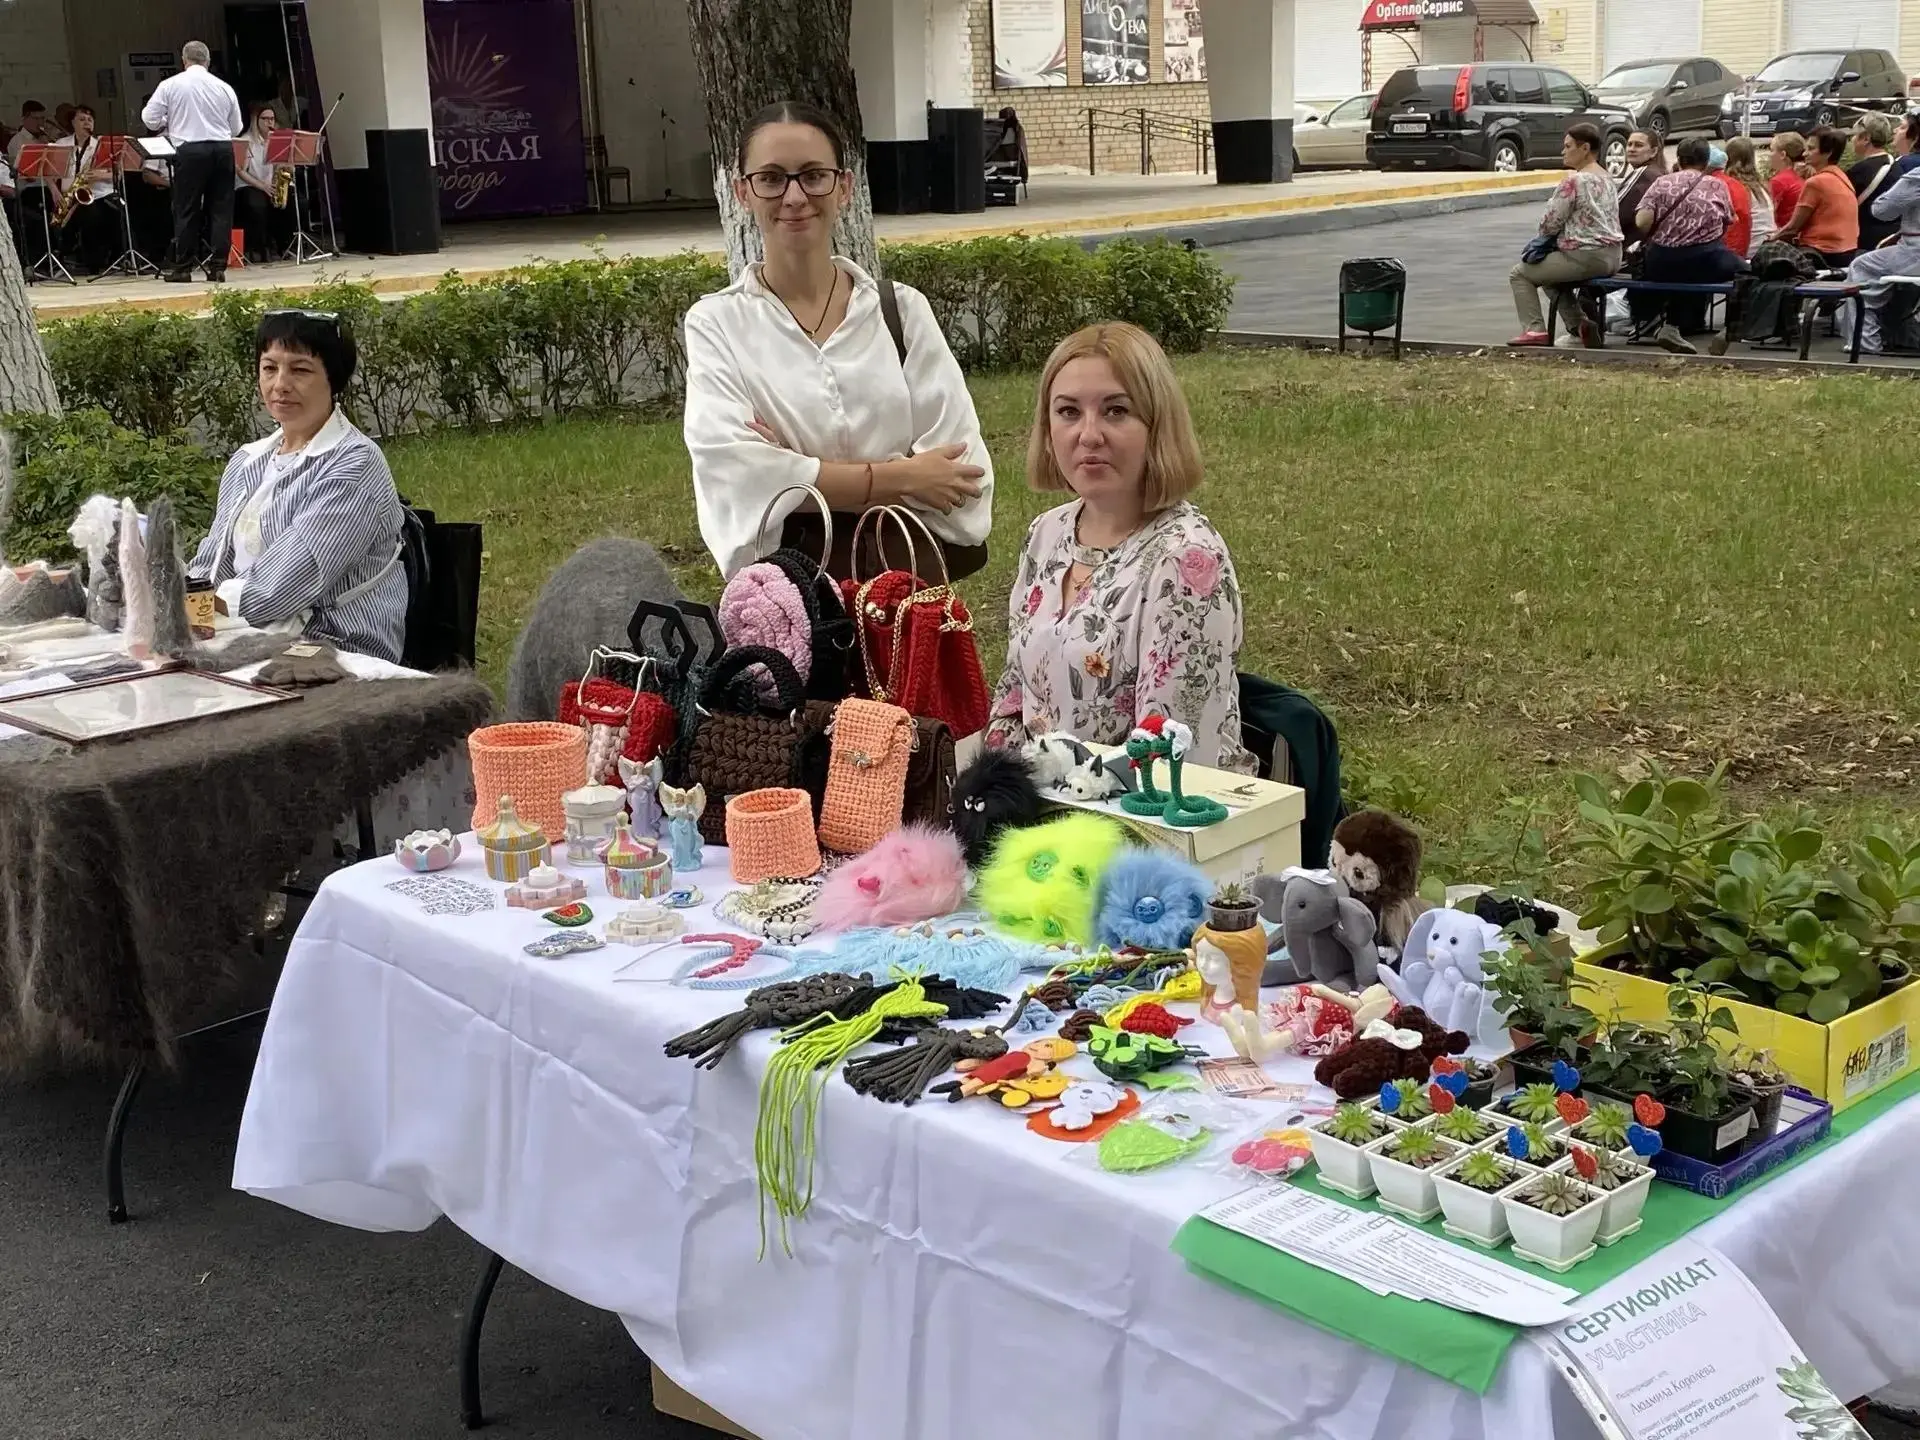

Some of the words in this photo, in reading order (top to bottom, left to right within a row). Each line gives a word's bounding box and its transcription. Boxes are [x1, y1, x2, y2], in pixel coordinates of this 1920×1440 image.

[1376, 0, 1464, 20] ОрТеплоСервис
[1563, 1257, 1718, 1344] СЕРТИФИКАТ
[1585, 1301, 1708, 1371] УЧАСТНИКА
[1630, 1386, 1673, 1416] Людмила
[1670, 1363, 1716, 1393] Королева
[1684, 1403, 1709, 1424] СТАРТ
[1707, 1401, 1716, 1411] В
